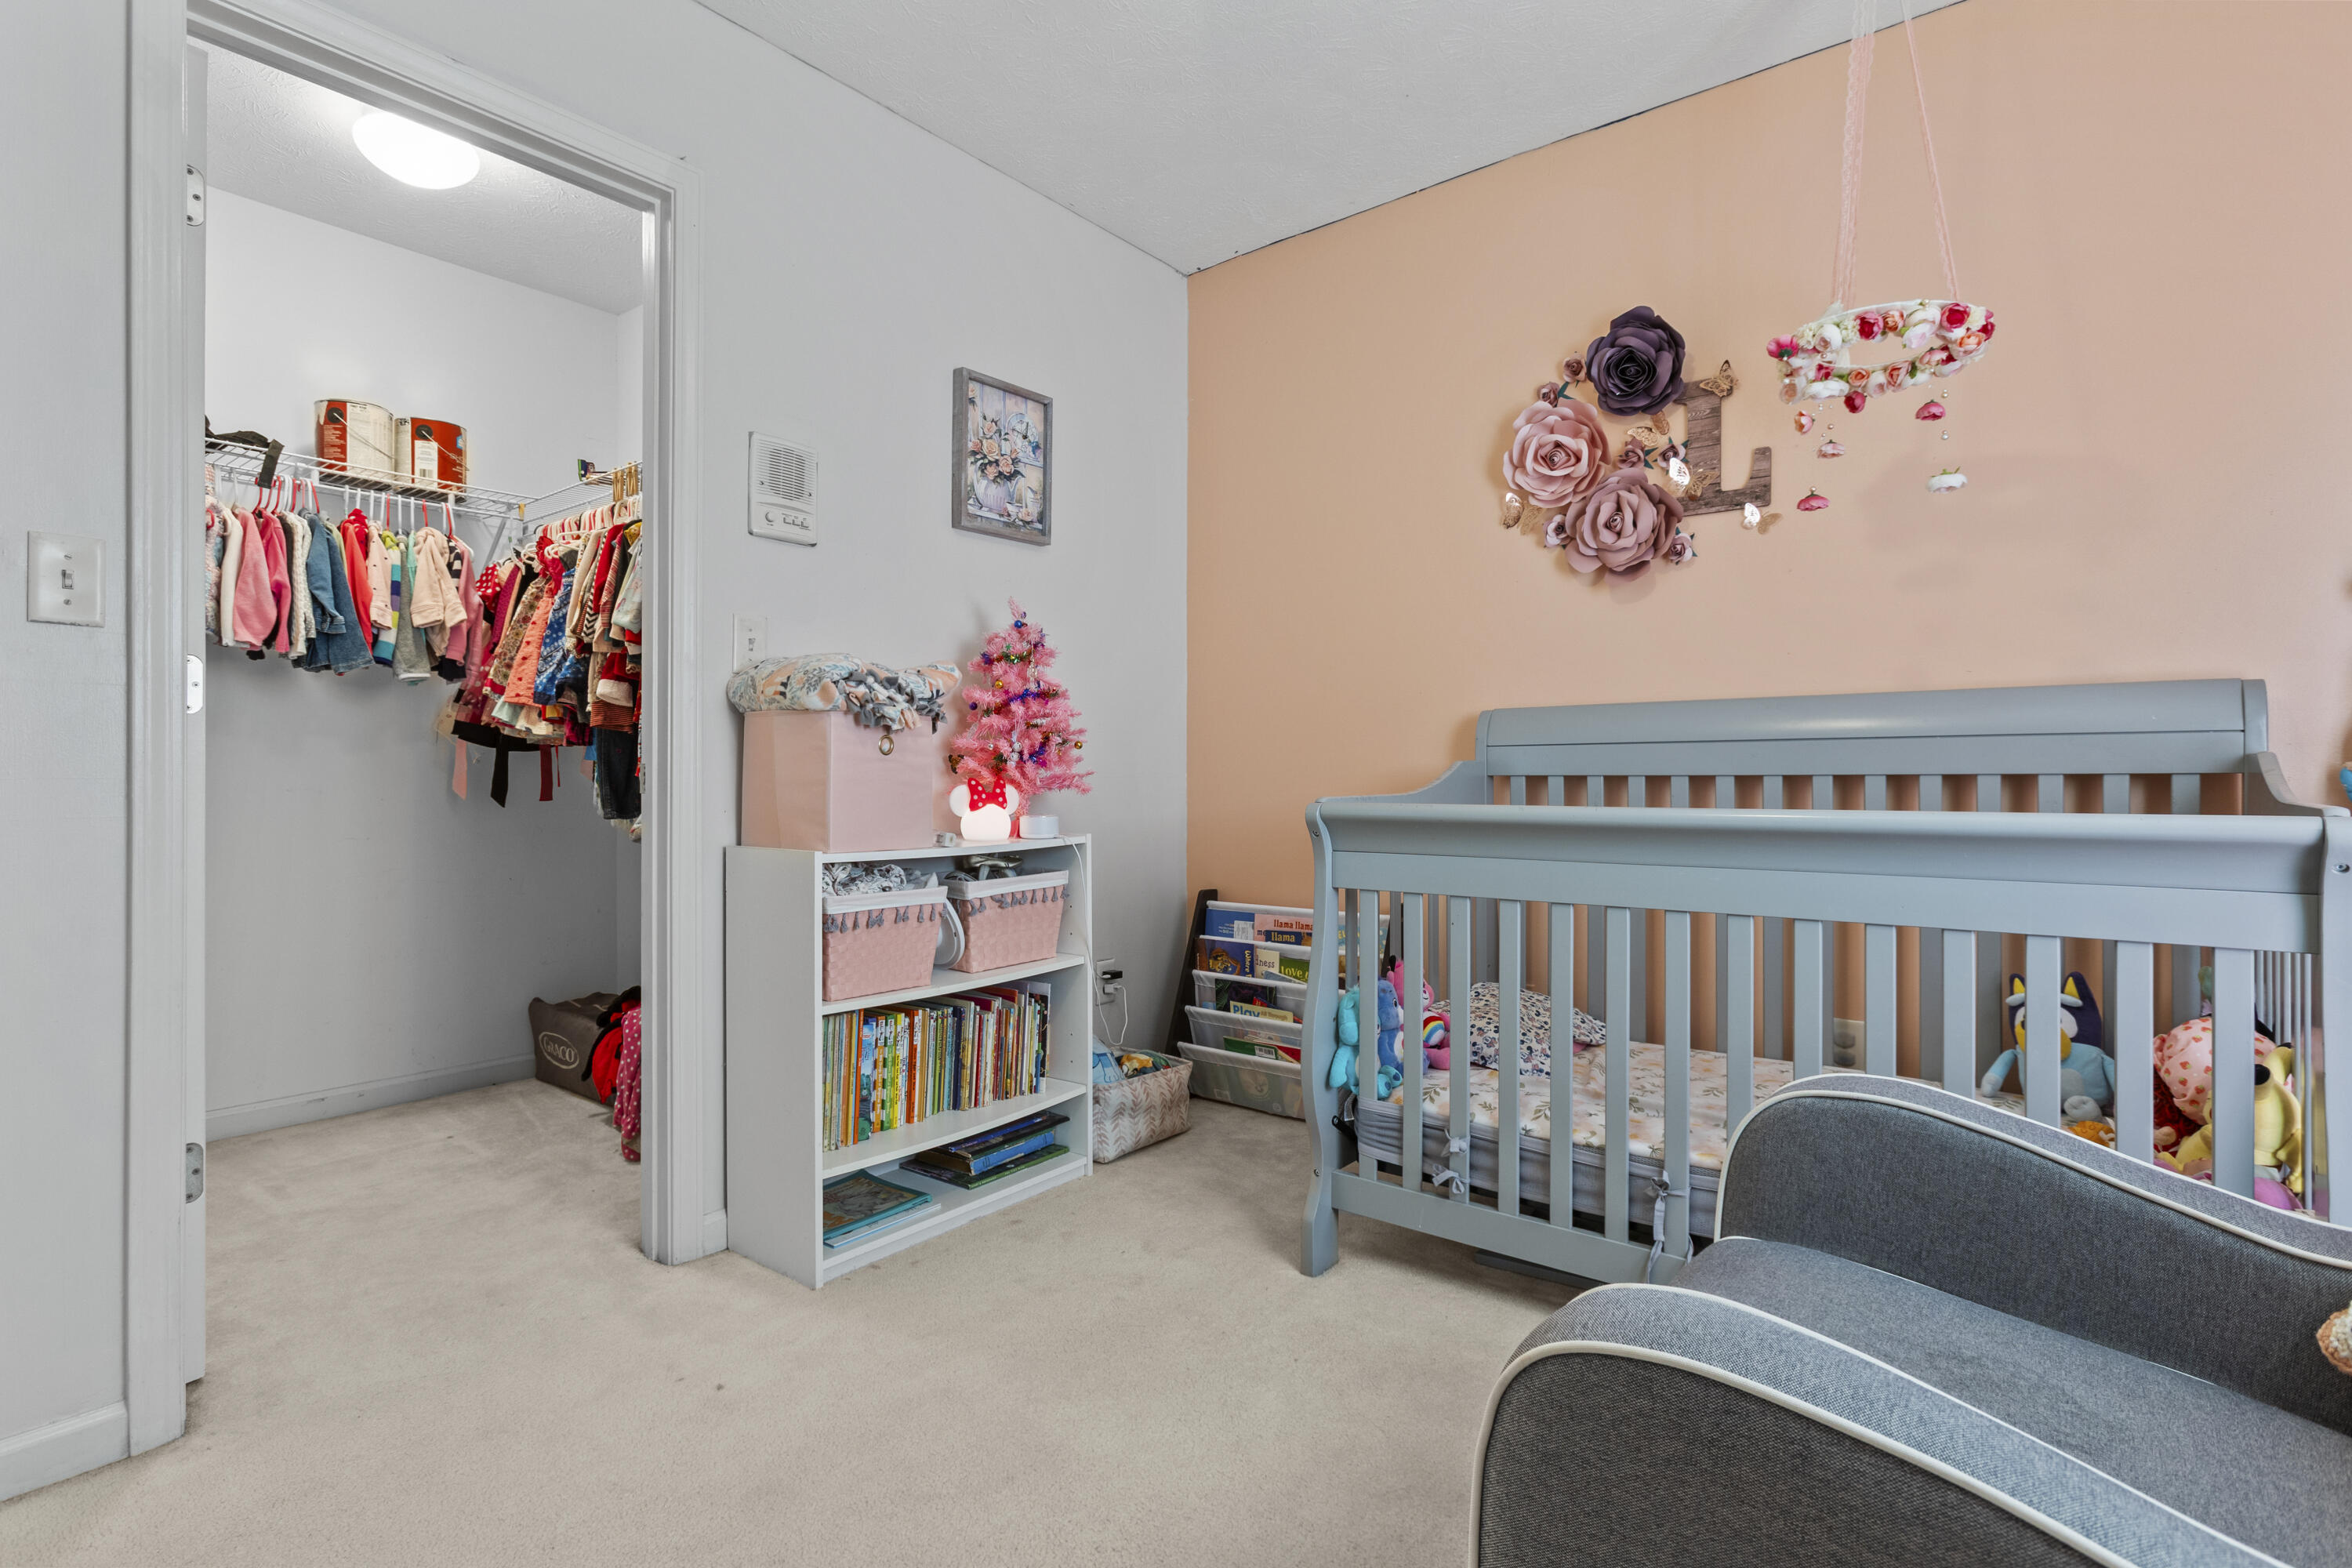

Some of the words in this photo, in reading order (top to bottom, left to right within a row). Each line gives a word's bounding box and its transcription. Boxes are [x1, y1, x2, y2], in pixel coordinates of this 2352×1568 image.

[1273, 919, 1294, 929] llama
[1271, 931, 1295, 942] llama
[543, 1036, 574, 1062] GRACO
